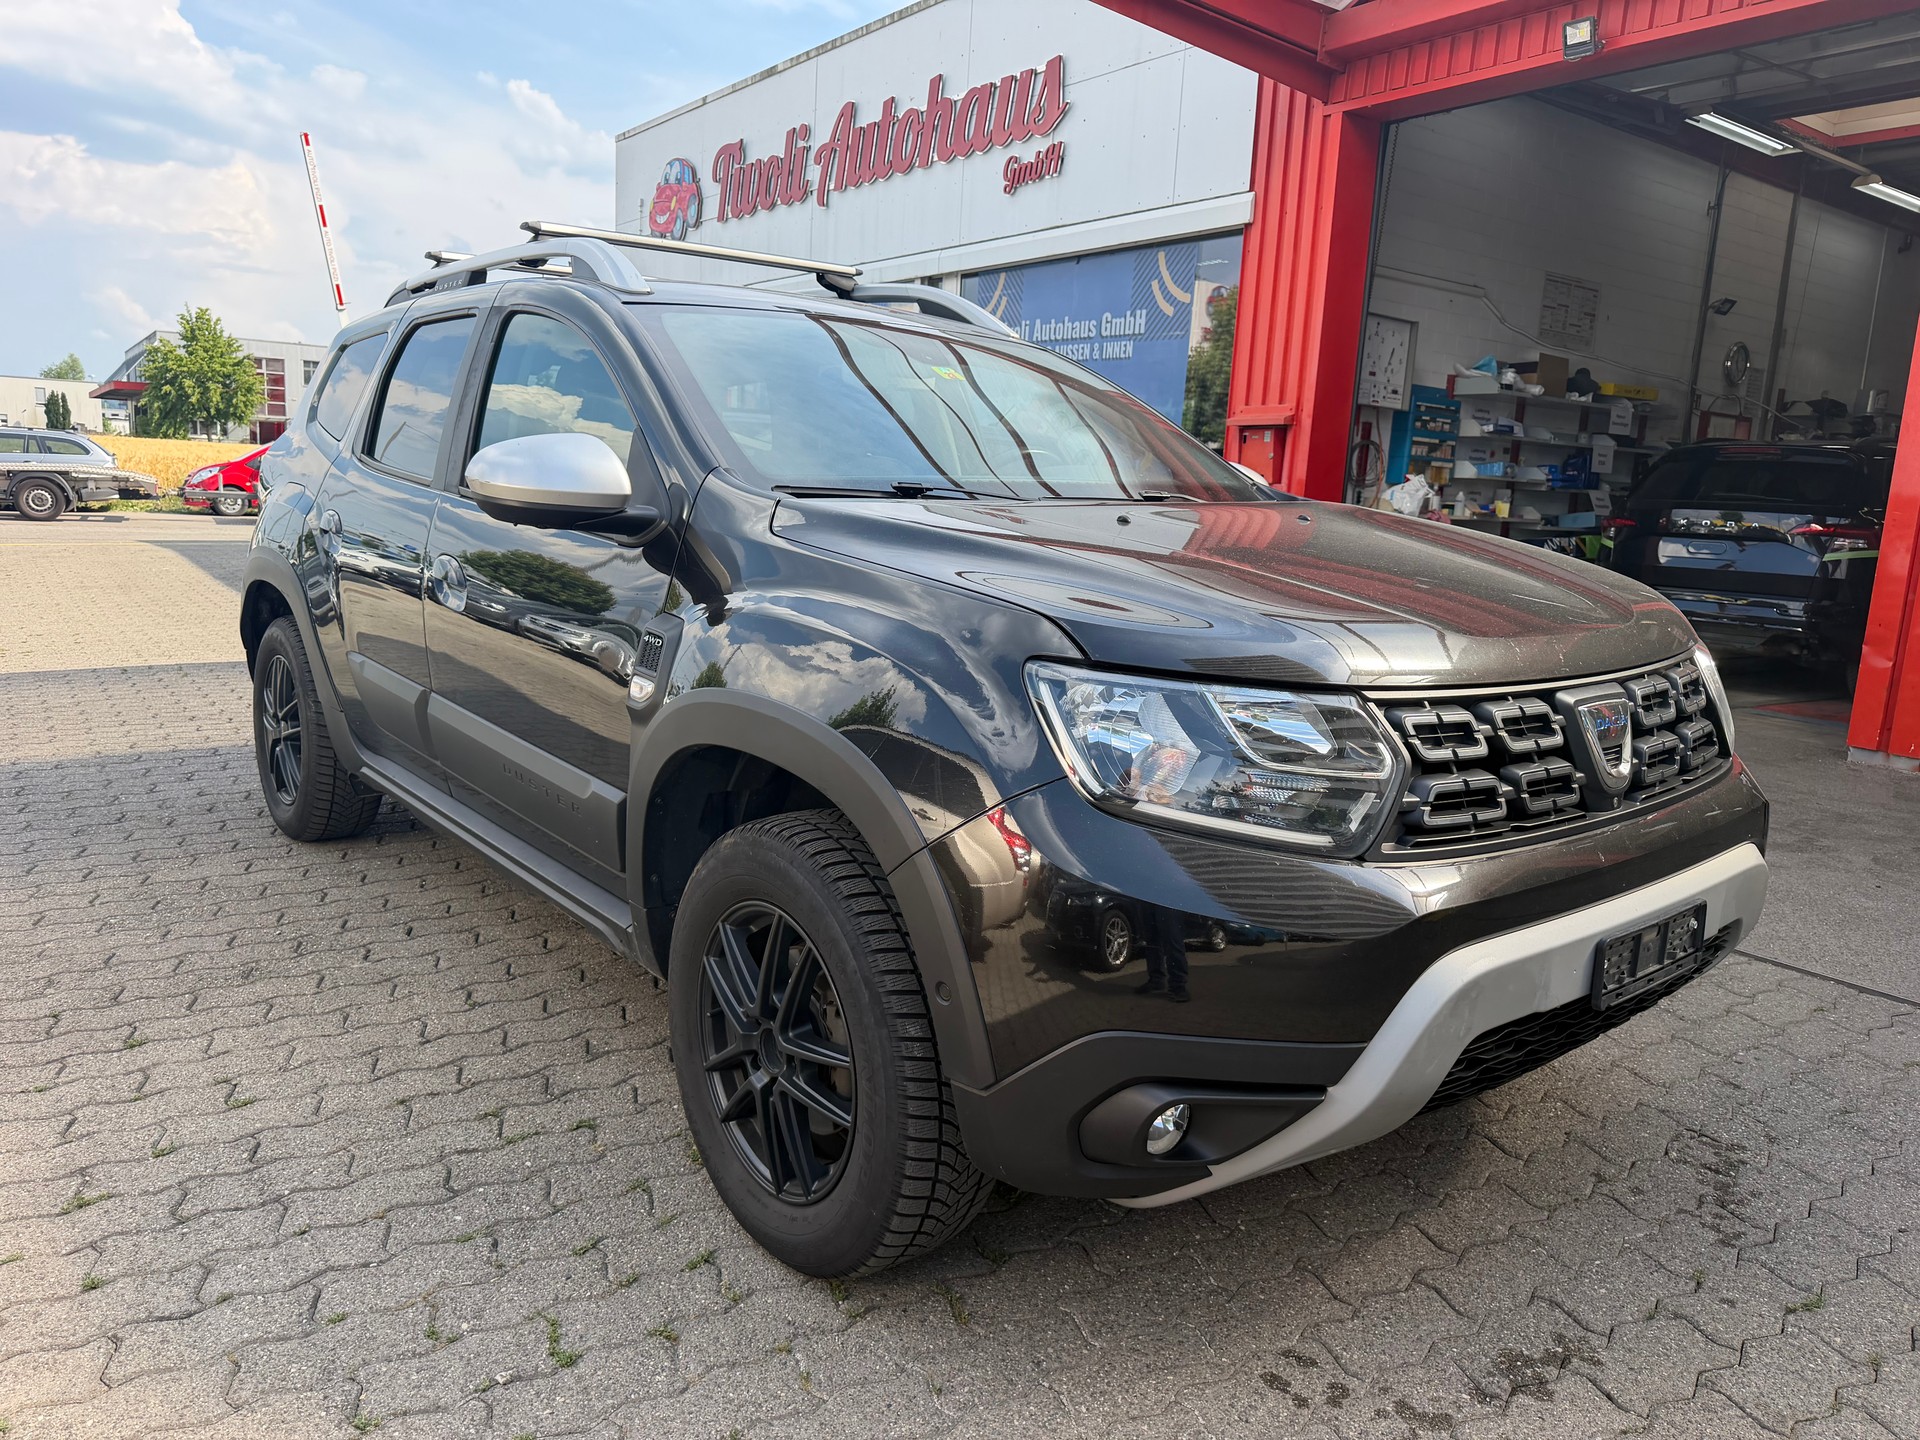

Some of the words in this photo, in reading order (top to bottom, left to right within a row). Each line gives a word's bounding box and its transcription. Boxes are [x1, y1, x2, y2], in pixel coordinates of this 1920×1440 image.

[712, 122, 811, 223] Tivoli
[814, 54, 1070, 209] Autohaus
[1003, 141, 1065, 195] GmbH
[1033, 315, 1097, 341] Autohaus
[1101, 309, 1147, 337] GmbH
[1093, 344, 1101, 360] &
[1102, 340, 1134, 360] INNEN
[643, 634, 662, 647] 4WD
[1596, 715, 1628, 730] DACIA
[503, 763, 582, 817] DUSTER
